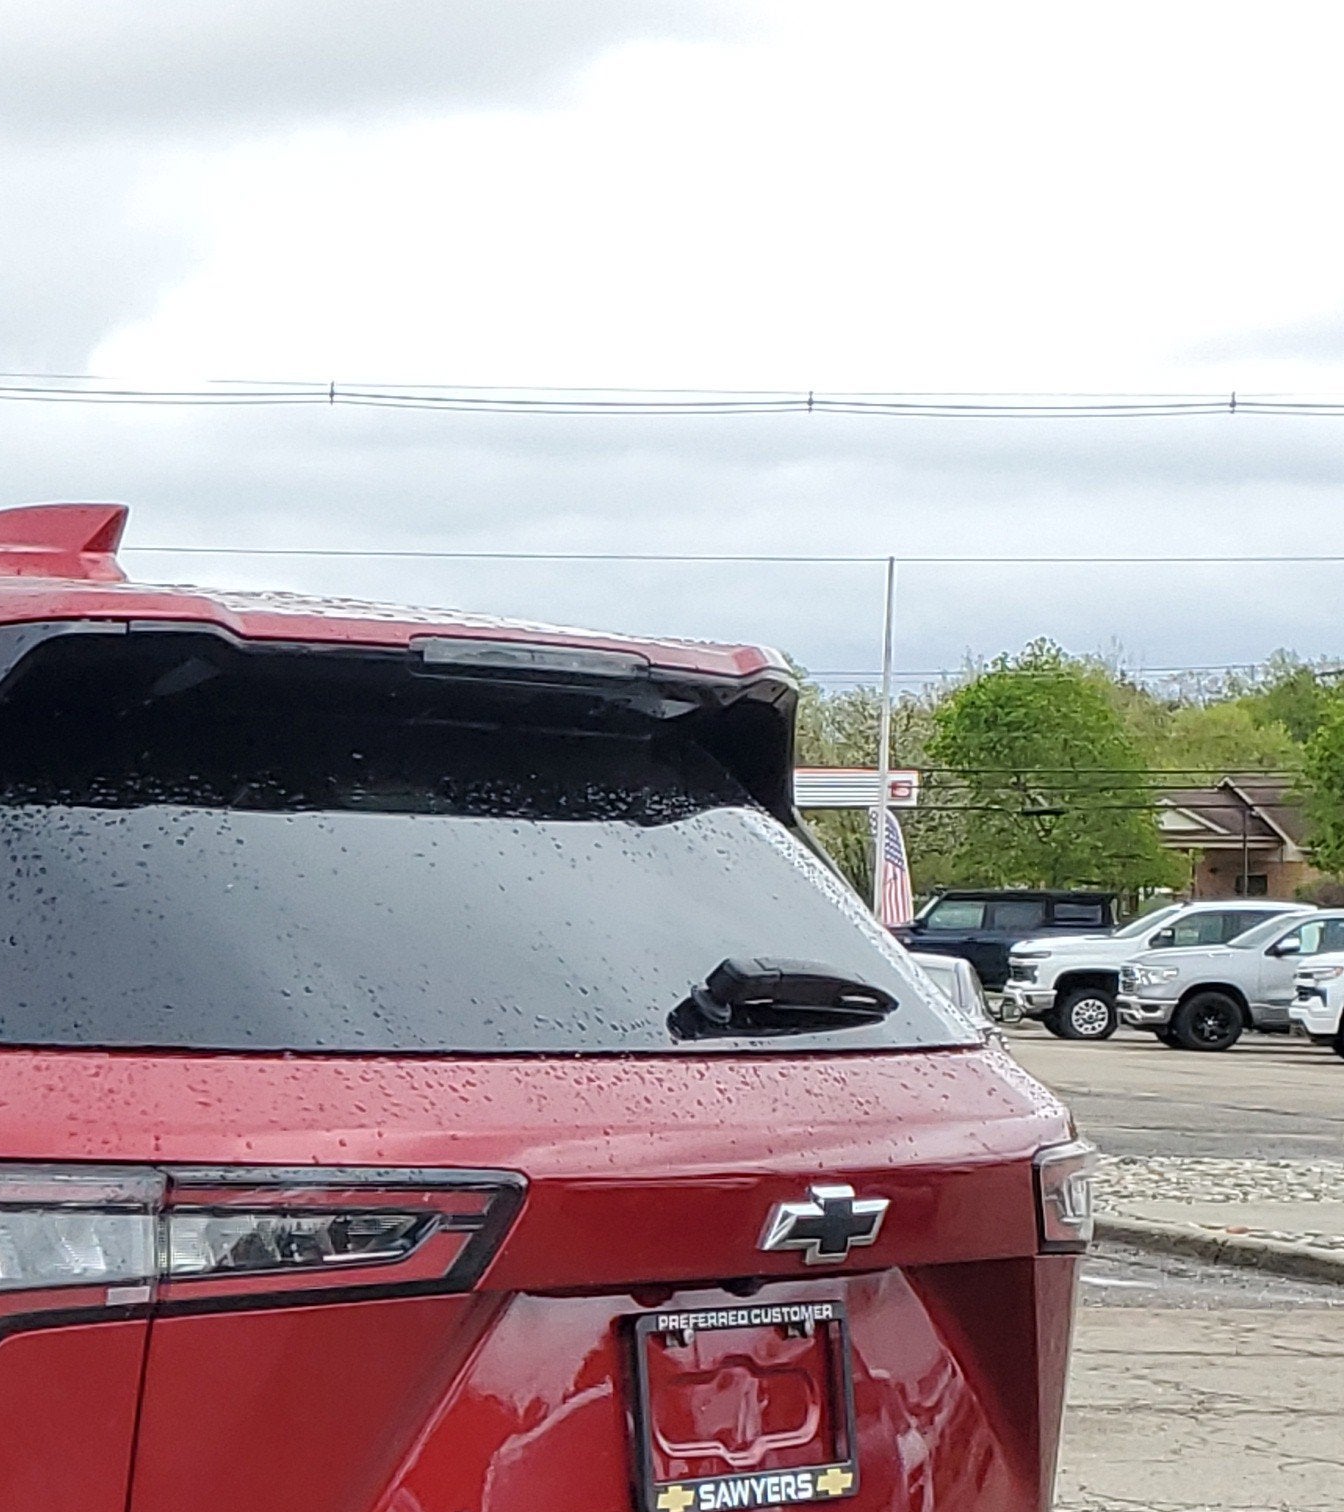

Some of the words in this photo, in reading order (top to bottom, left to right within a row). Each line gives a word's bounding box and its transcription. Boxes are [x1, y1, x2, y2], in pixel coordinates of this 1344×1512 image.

[658, 1310, 749, 1331] PREFERRED
[750, 1304, 833, 1324] CUSTOMER
[699, 1473, 813, 1511] SAWYERS
